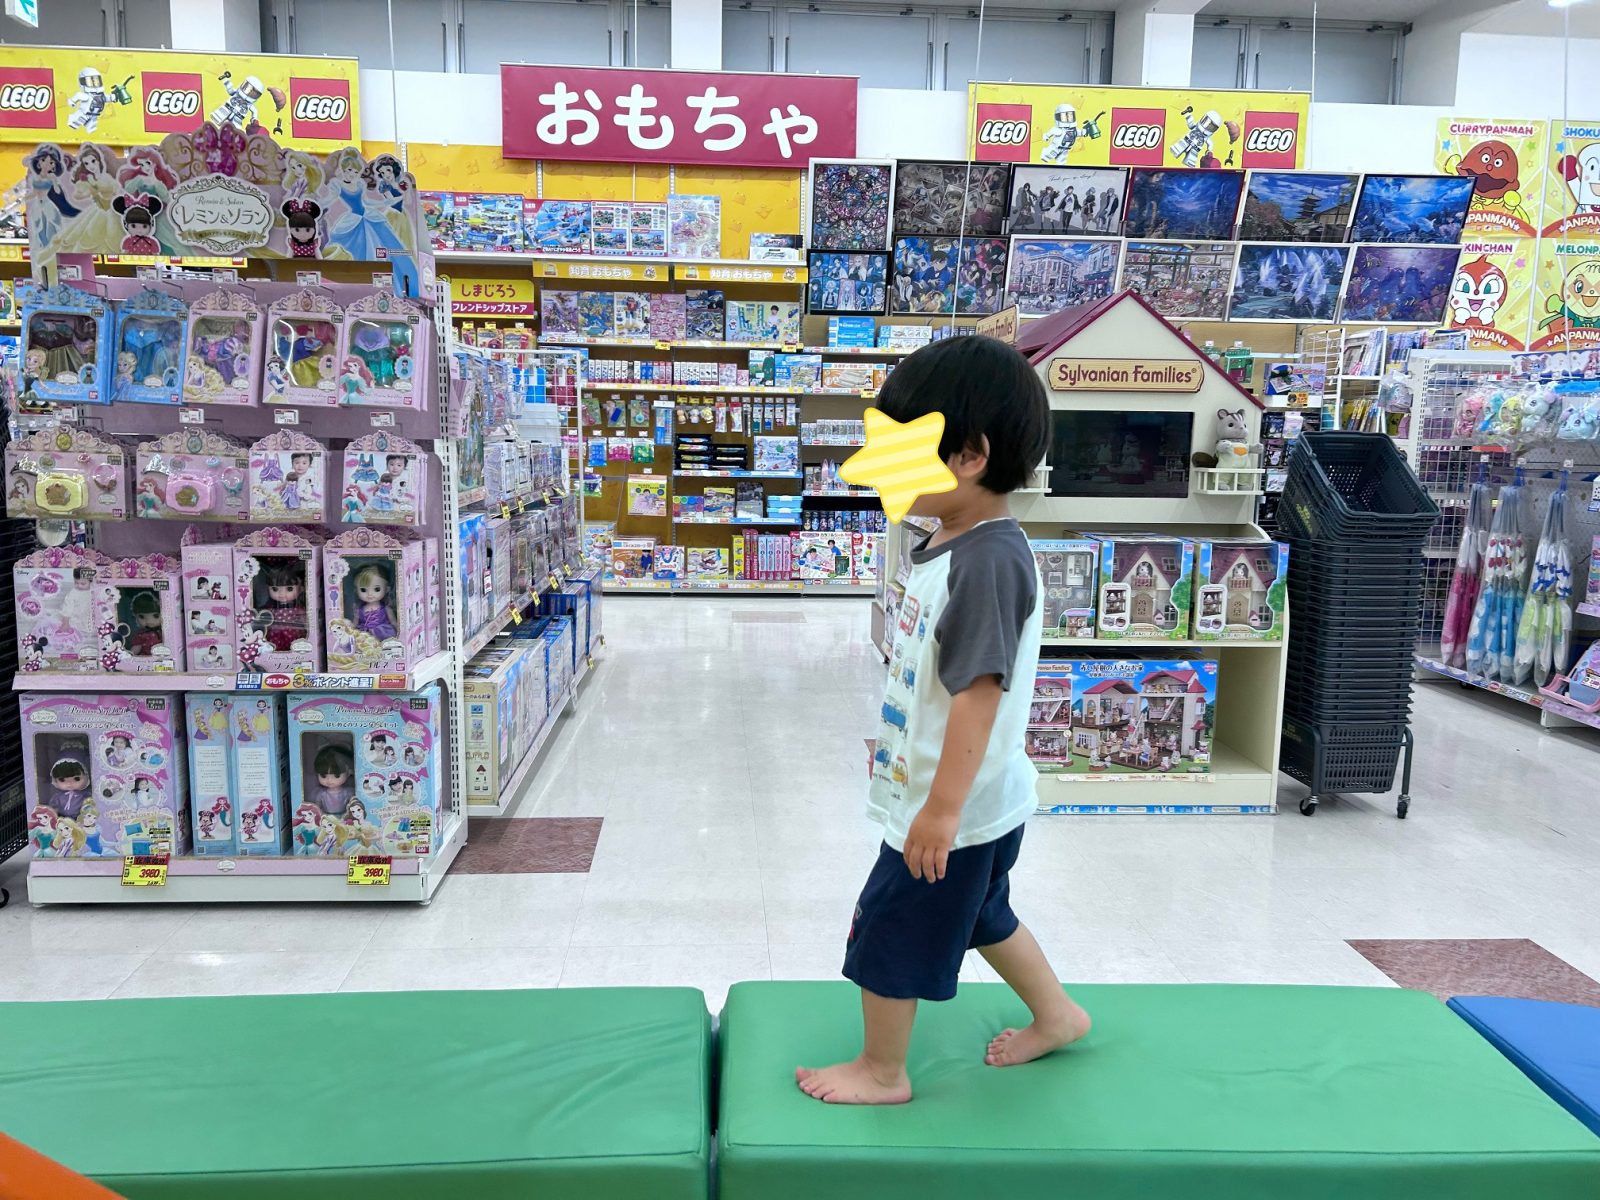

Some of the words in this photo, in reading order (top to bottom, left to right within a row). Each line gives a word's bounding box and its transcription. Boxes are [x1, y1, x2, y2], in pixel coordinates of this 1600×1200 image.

[1, 85, 51, 110] LEGO
[148, 90, 199, 116] LEGO
[296, 97, 347, 122] LEGO
[536, 81, 818, 158] おもちゃ
[979, 120, 1028, 146] LEGO
[1114, 125, 1163, 149] LEGO
[1247, 128, 1296, 152] LEGO
[1450, 124, 1533, 136] CURRYPANMAN
[181, 205, 266, 225] レミン&ソラン
[1557, 245, 1600, 254] MELONP
[461, 284, 516, 298] しまじろう
[452, 303, 527, 313] フレンドシップストア
[1553, 331, 1600, 344] ANPANM
[1058, 363, 1129, 386] Sylvanian
